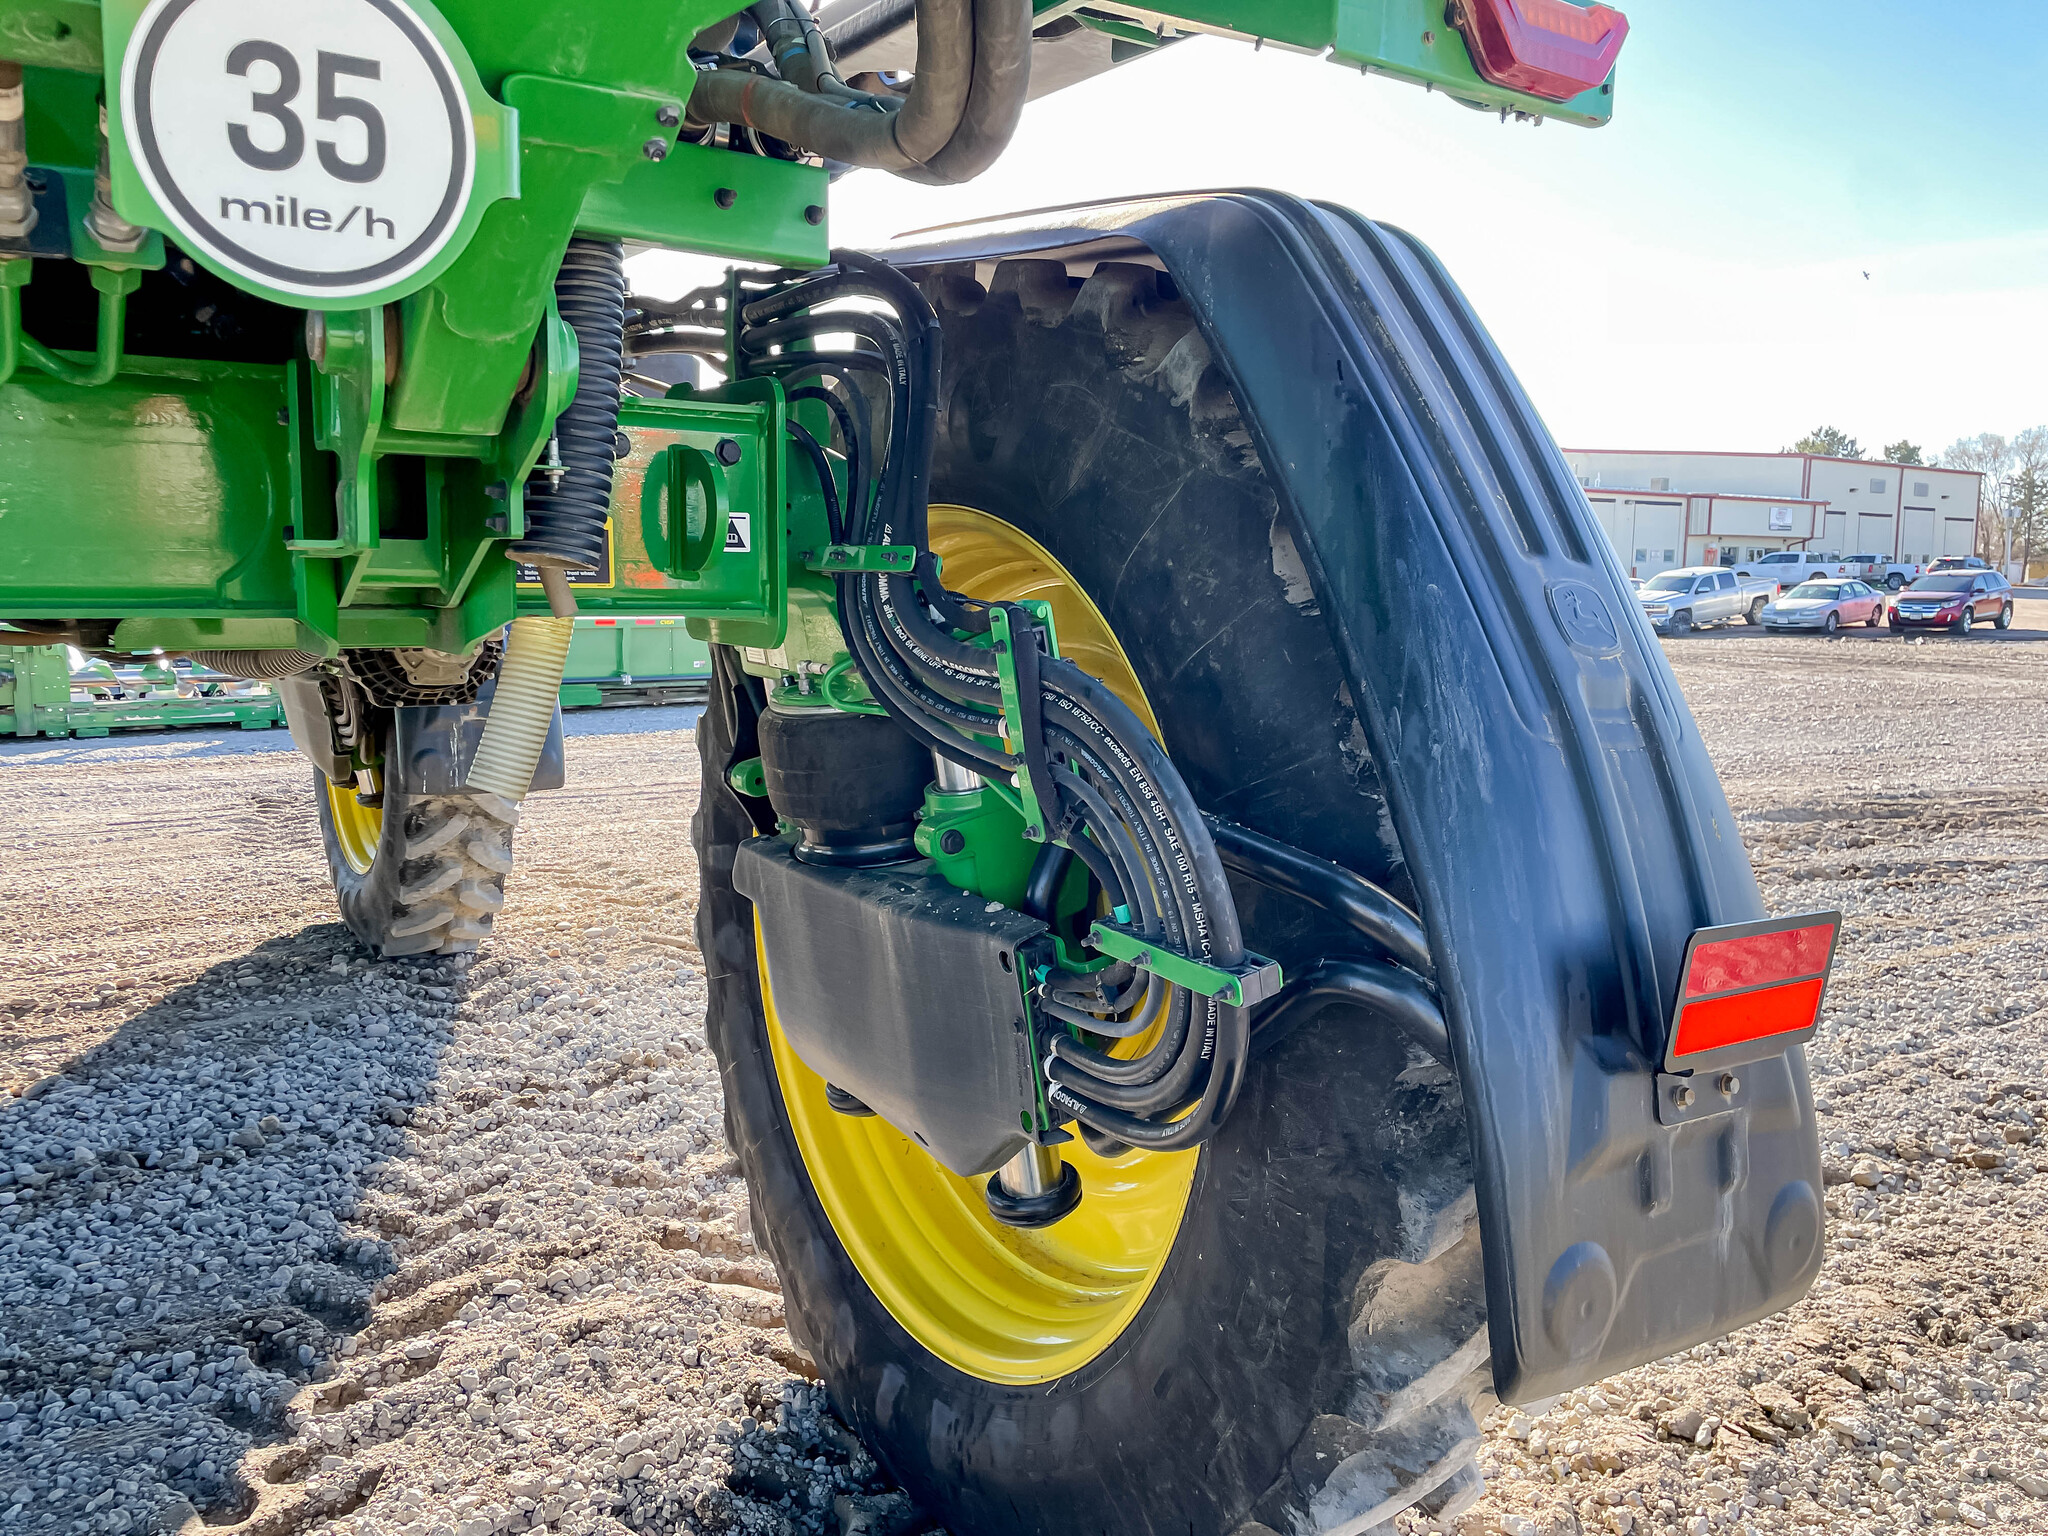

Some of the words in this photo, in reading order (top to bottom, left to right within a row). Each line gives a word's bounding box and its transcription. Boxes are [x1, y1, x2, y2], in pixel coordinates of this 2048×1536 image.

[226, 39, 387, 184] 35
[220, 195, 395, 240] mile/h
[898, 367, 907, 386] ITALY
[912, 647, 943, 670] MINETUFF
[1058, 698, 1073, 710] ISO
[1071, 706, 1103, 735] 18752/CC
[1104, 736, 1132, 768] exceeds
[1129, 767, 1144, 782] EN
[1138, 781, 1154, 799] 856
[1150, 800, 1167, 821] 4SH
[1164, 827, 1181, 852] SAE
[1175, 852, 1189, 872] 100
[1182, 873, 1197, 894] R15
[1191, 902, 1208, 937] MSHA
[1133, 821, 1148, 841] ITALY
[1144, 843, 1153, 853] IN
[1150, 856, 1161, 875] MADE
[1158, 877, 1166, 887] 22
[1207, 997, 1217, 1026] MADE
[1205, 1028, 1215, 1037] IN
[1200, 1038, 1214, 1060] ITALY
